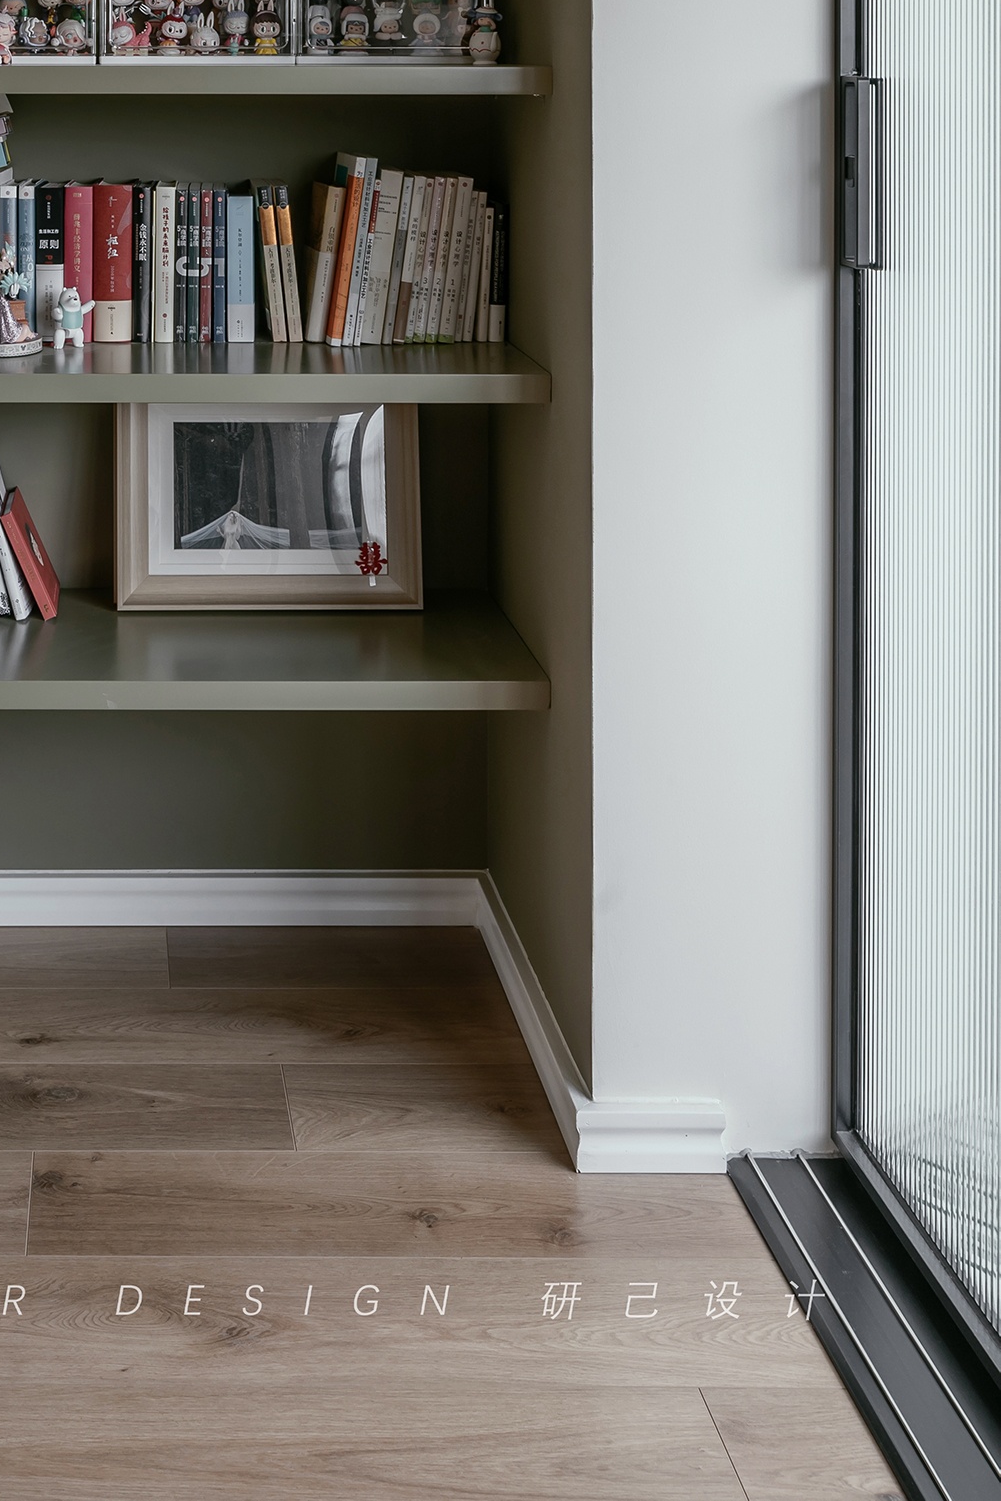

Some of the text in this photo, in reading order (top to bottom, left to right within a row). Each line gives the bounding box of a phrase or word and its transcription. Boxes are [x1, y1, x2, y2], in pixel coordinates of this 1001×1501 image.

[38, 239, 60, 250] 原则
[106, 234, 119, 259] 枢纽
[138, 223, 147, 262] 金钱永不眠
